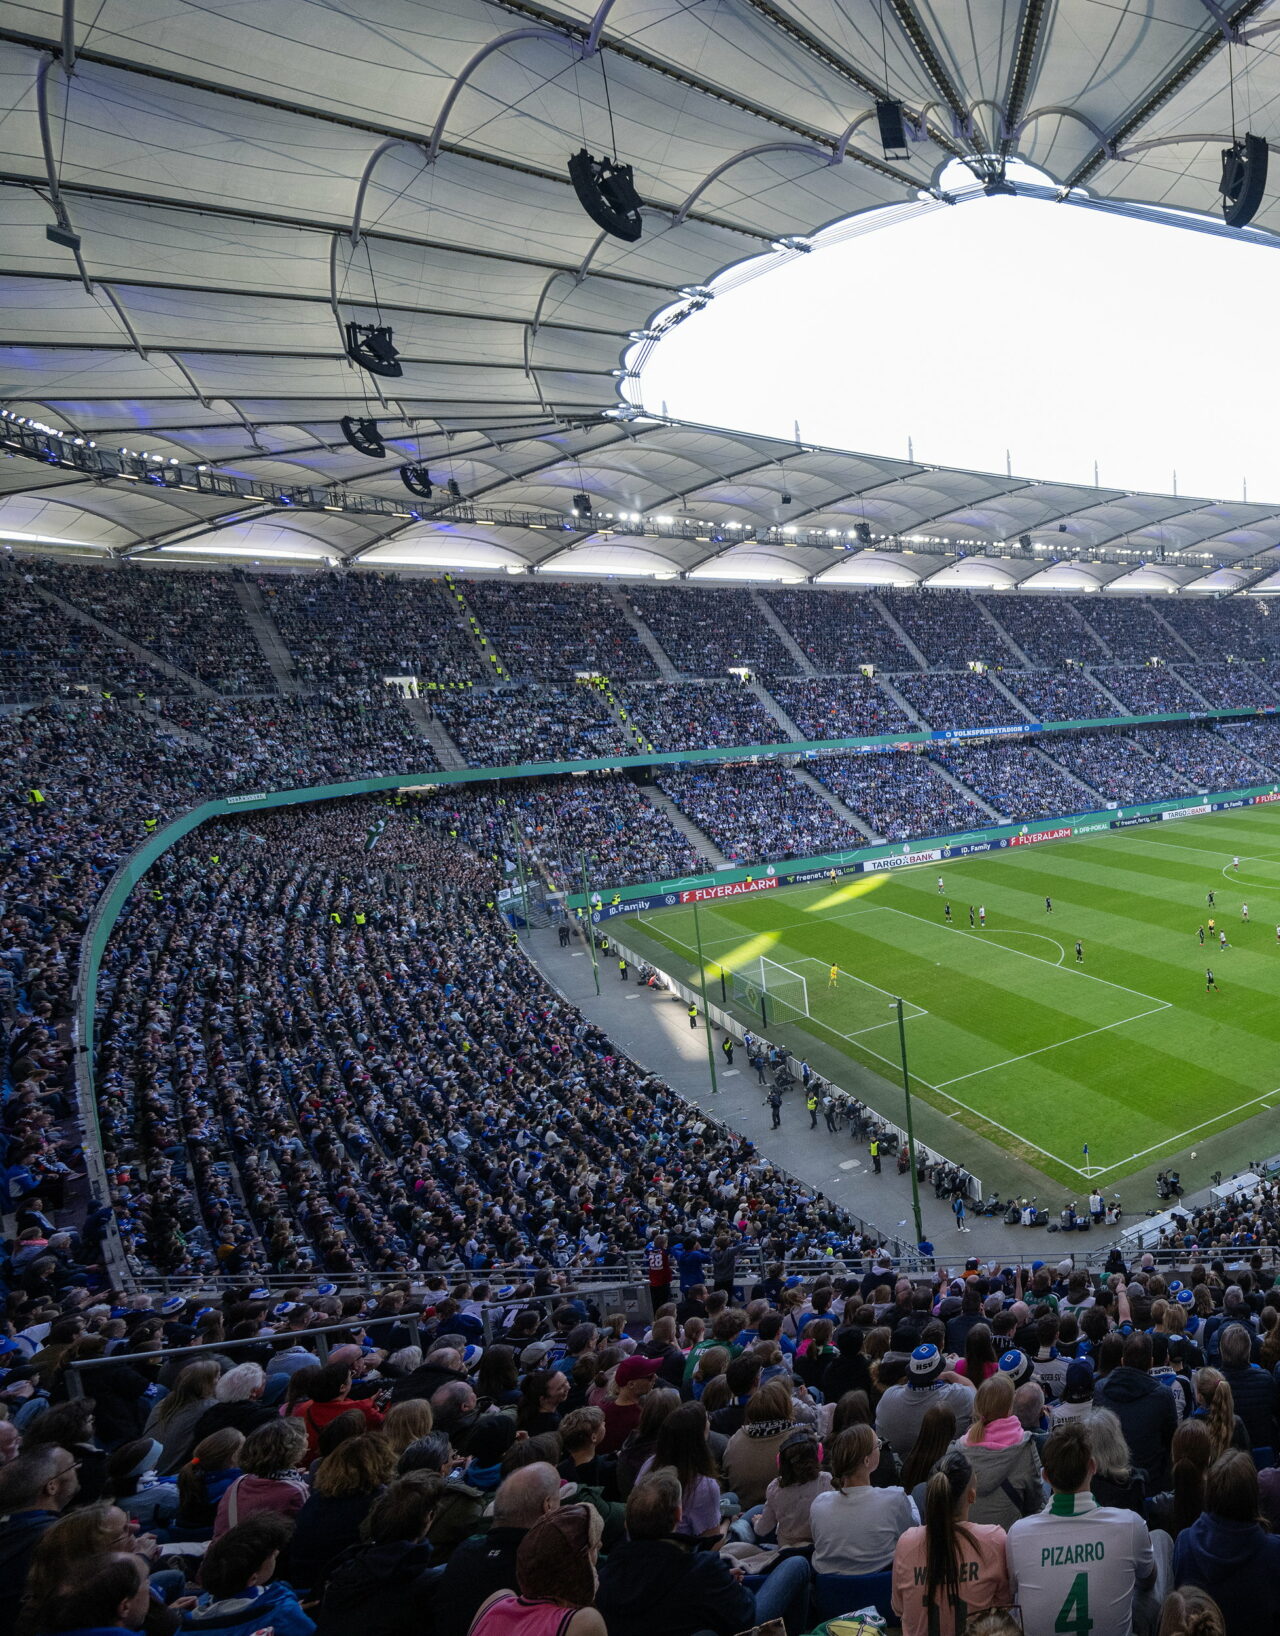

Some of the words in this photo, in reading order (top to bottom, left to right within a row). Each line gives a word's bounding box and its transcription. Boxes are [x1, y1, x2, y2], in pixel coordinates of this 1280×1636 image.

[953, 726, 1023, 737] VOLKSPARKSTADION
[1079, 823, 1108, 834] DFB-POKAL
[1019, 829, 1071, 845] FLYERALARM
[961, 846, 970, 854] ID.
[970, 843, 991, 852] Family
[695, 877, 777, 901] FLYERALARM
[609, 903, 618, 916] ID.
[619, 900, 650, 912] Family
[649, 1254, 663, 1267] 28
[916, 1361, 933, 1371] HSV
[1041, 1541, 1105, 1567] PIZARRO
[1054, 1572, 1094, 1636] 4
